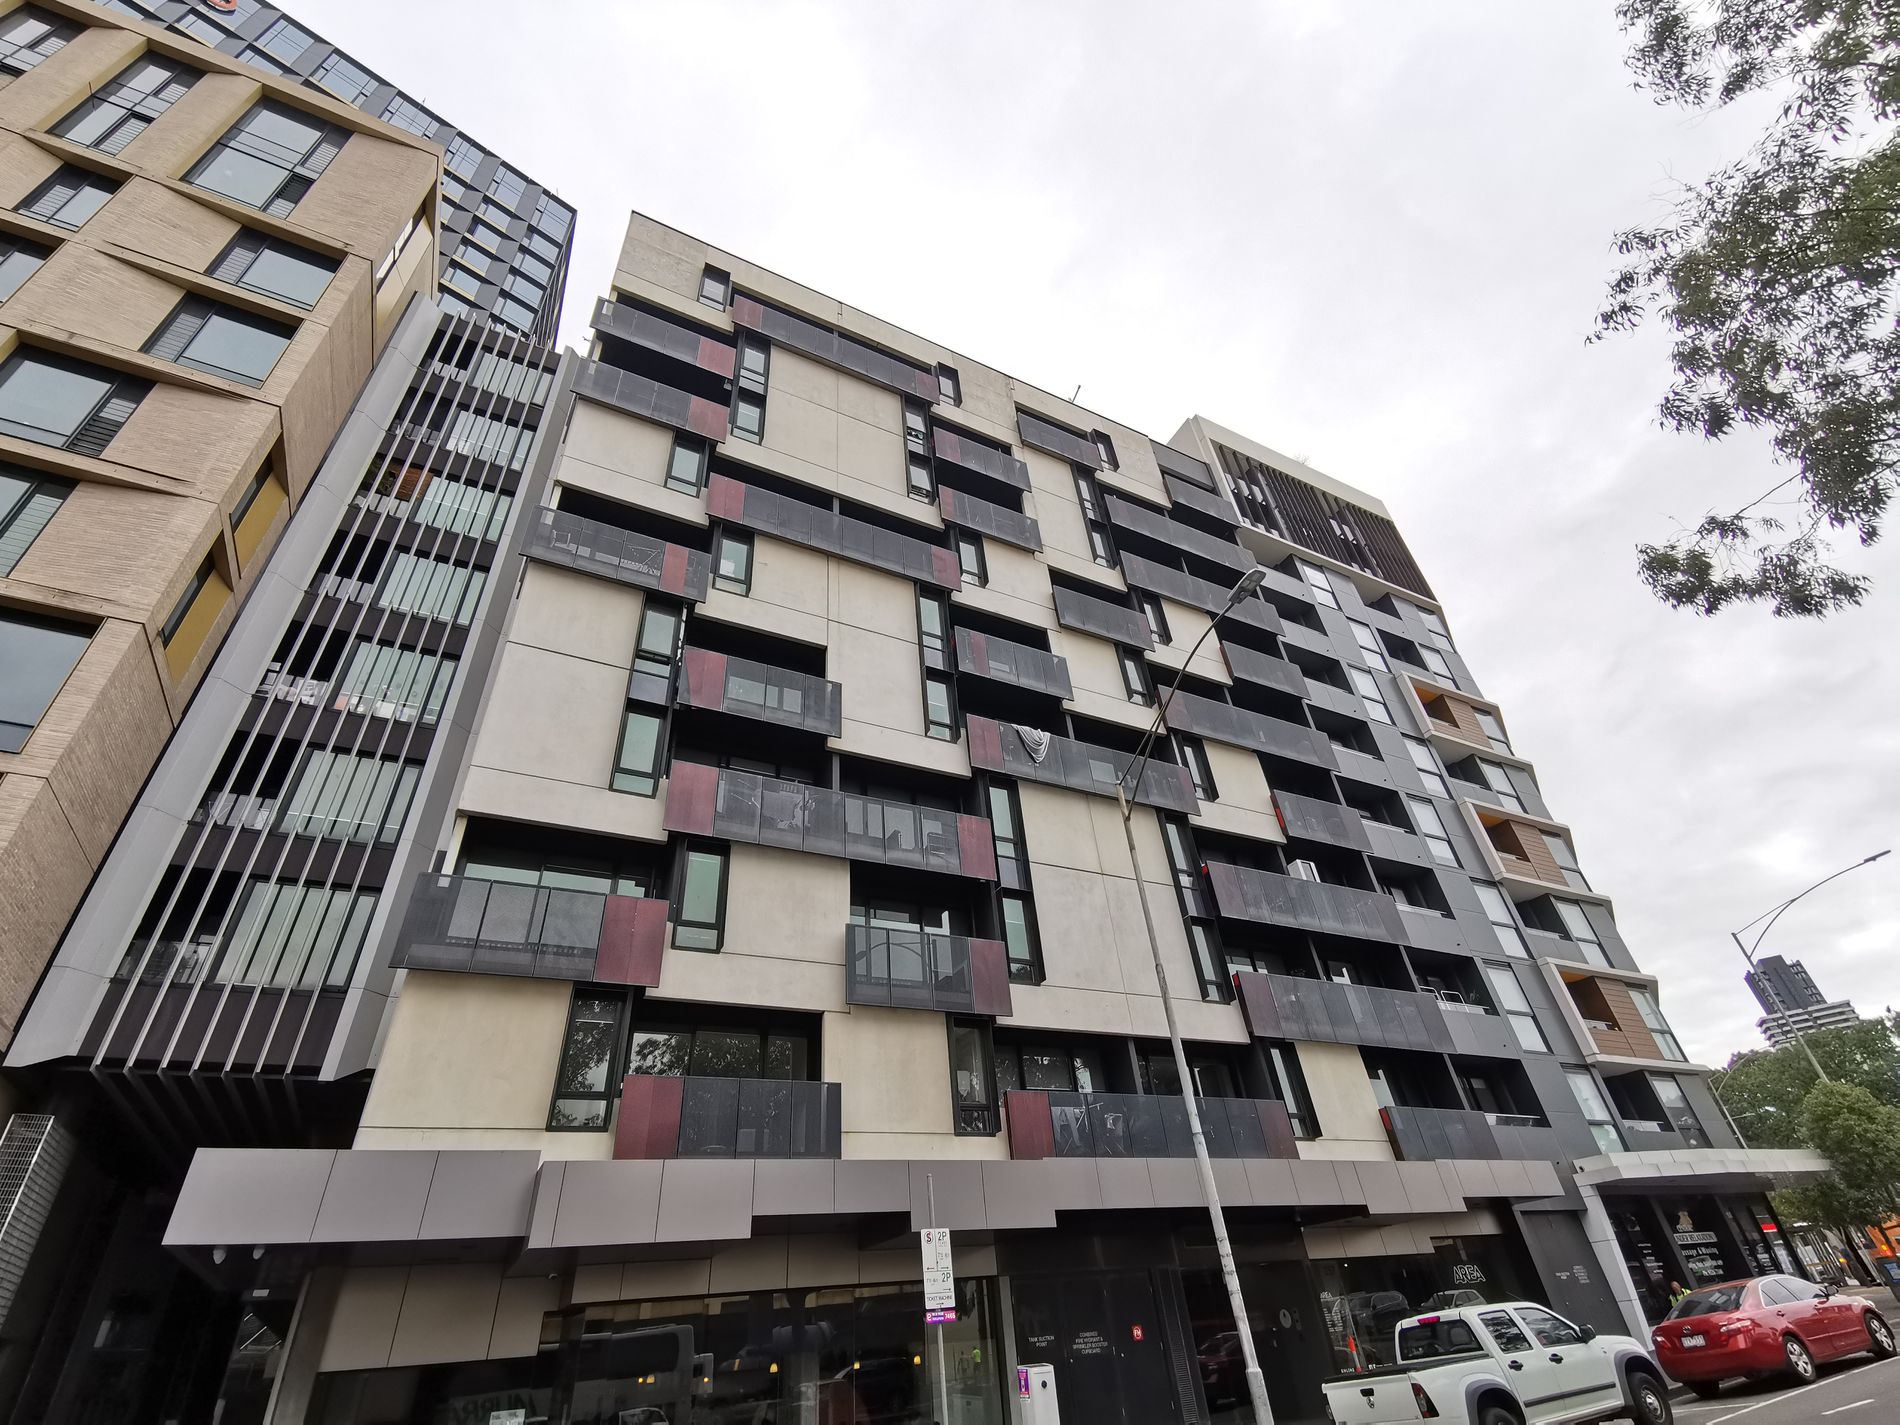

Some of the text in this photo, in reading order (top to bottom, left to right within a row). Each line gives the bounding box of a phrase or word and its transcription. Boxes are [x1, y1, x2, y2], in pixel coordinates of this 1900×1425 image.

[937, 1231, 947, 1241] 2P
[941, 1272, 951, 1283] 2P
[1453, 1264, 1486, 1284] AREA
